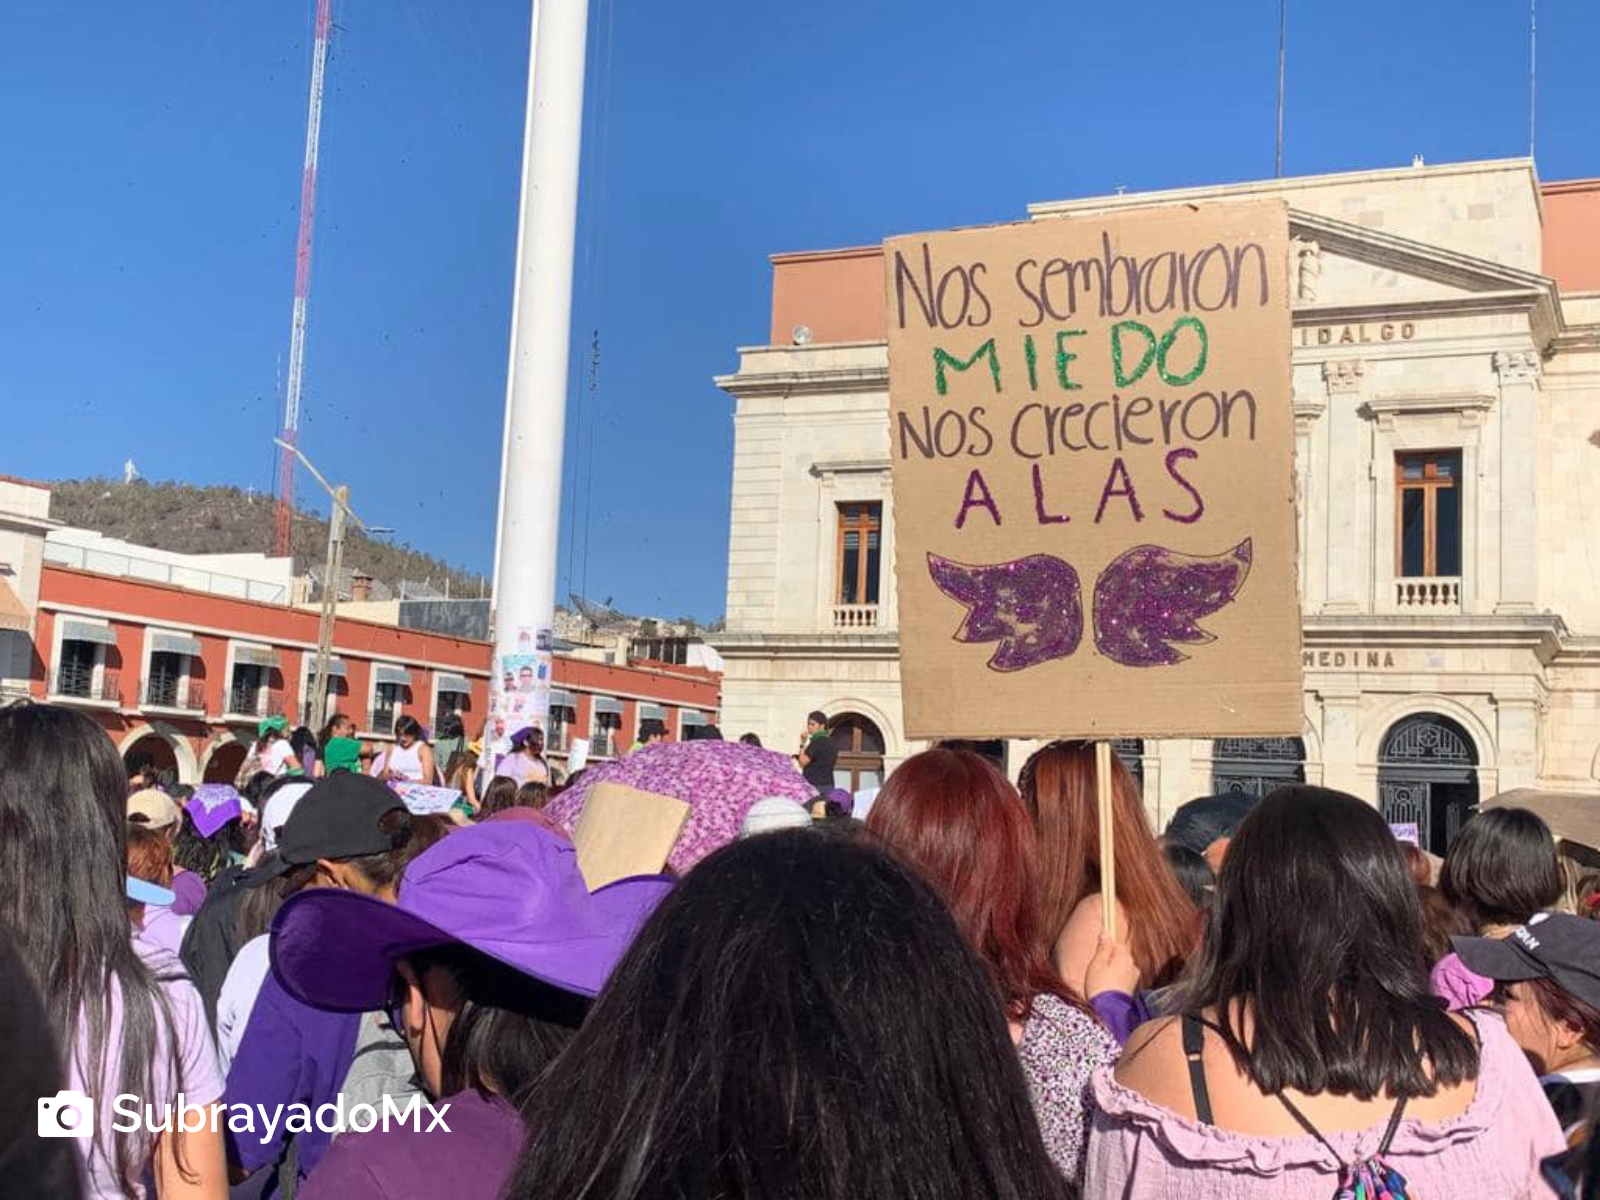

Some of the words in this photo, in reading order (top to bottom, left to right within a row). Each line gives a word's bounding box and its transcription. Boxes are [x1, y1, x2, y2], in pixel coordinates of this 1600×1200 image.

[895, 242, 991, 329] Nos
[1015, 231, 1269, 327] sembraron
[933, 316, 1209, 396] MIEDO
[954, 447, 1205, 529] ALAS
[1302, 651, 1394, 668] MEDINA
